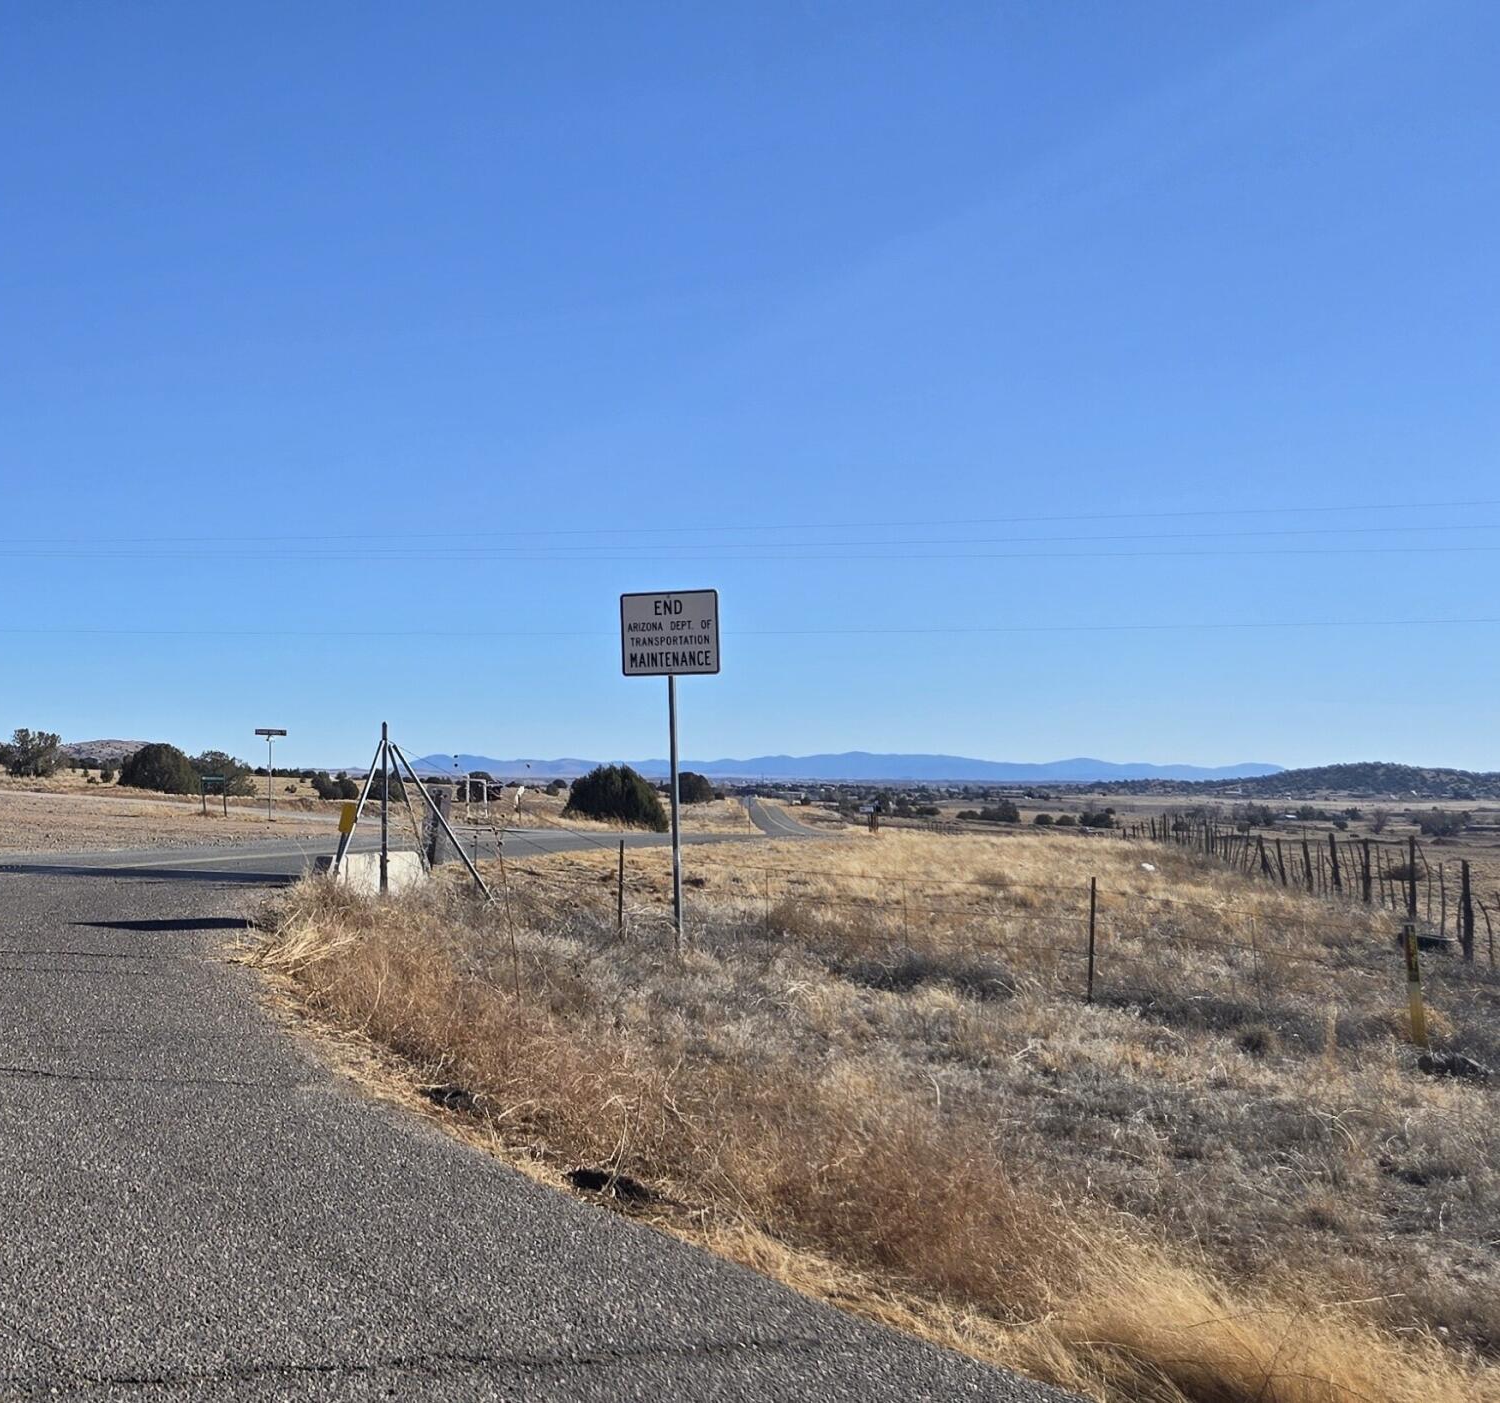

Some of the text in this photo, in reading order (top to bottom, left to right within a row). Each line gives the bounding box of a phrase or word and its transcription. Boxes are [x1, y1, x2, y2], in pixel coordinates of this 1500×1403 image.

[654, 599, 683, 616] END
[627, 619, 712, 632] ARIZONA DEPT. OF
[630, 634, 710, 647] TRANSPORTATION
[629, 650, 712, 669] MAINTENANCE
